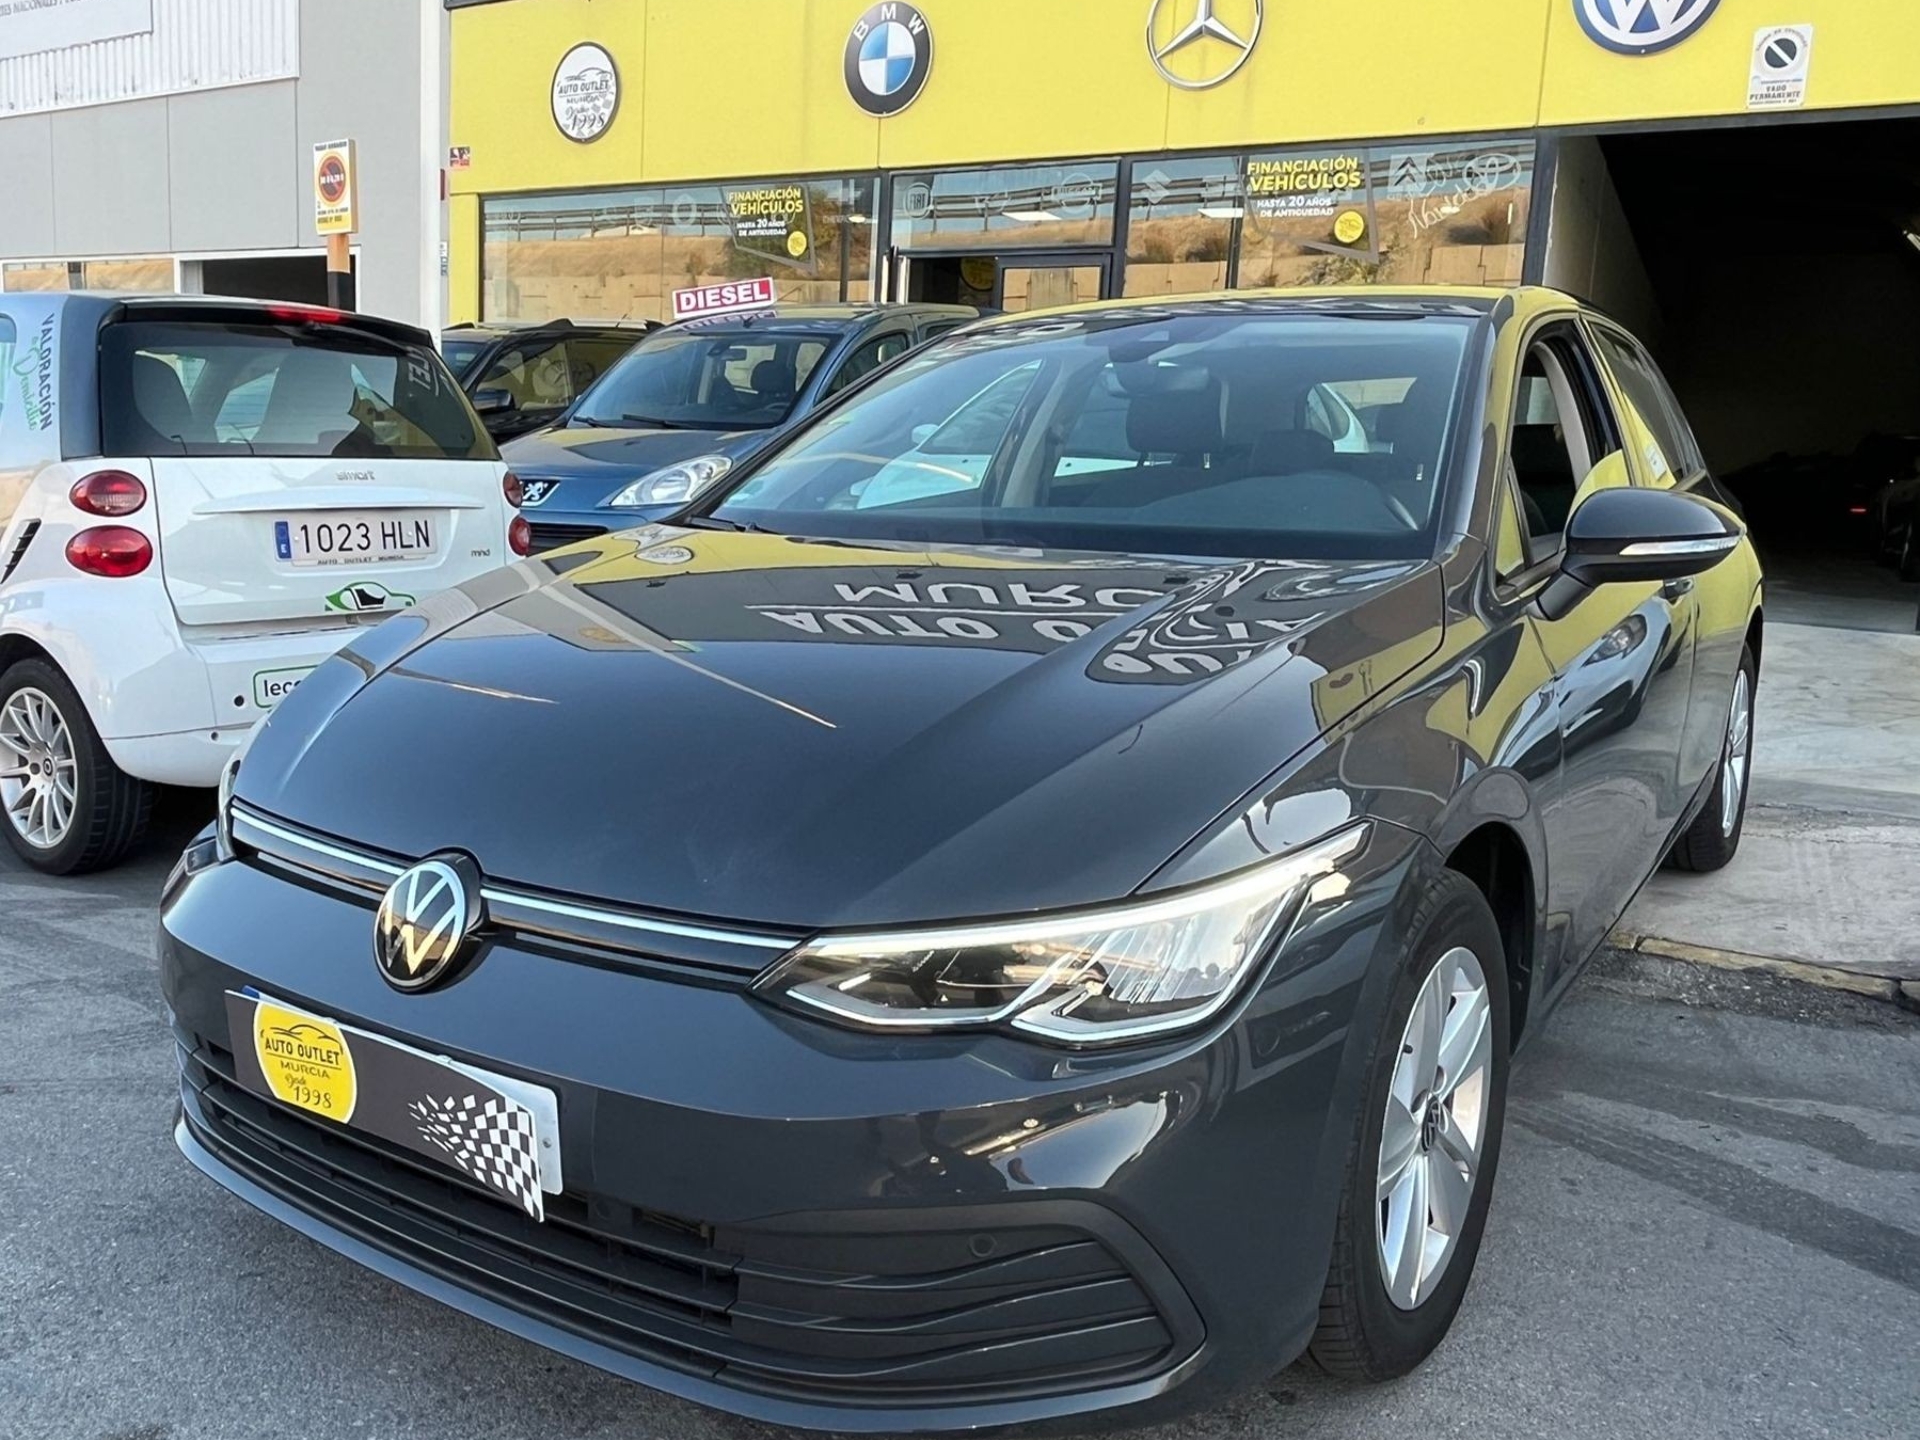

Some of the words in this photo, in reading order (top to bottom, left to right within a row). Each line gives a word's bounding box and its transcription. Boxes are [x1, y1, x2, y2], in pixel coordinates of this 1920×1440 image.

[853, 3, 925, 41] BMW
[558, 83, 578, 94] AUTO
[580, 79, 609, 92] OUTLET
[1749, 90, 1801, 101] PERMANENTE
[571, 112, 606, 131] 1998
[1246, 154, 1358, 175] FINANCIACIÓN
[1249, 171, 1361, 192] VEHÍCULOS
[728, 185, 801, 201] FINANCIACIÓN
[1257, 199, 1286, 208] HASTA
[1288, 196, 1304, 207] 20
[1306, 196, 1332, 206] AÑOS
[731, 199, 804, 216] VEHÍCULOS
[1260, 208, 1273, 218] DE
[756, 218, 768, 228] 20
[679, 282, 769, 311] DIESEL
[39, 312, 56, 431] VALORACIÓN
[300, 522, 371, 554] 1023
[381, 520, 430, 550] HLN
[263, 679, 301, 697] lec
[265, 1038, 293, 1055] AUTO
[297, 1044, 340, 1066] OUTLET
[280, 1060, 331, 1080] MURCIA
[293, 1086, 332, 1109] 1998
